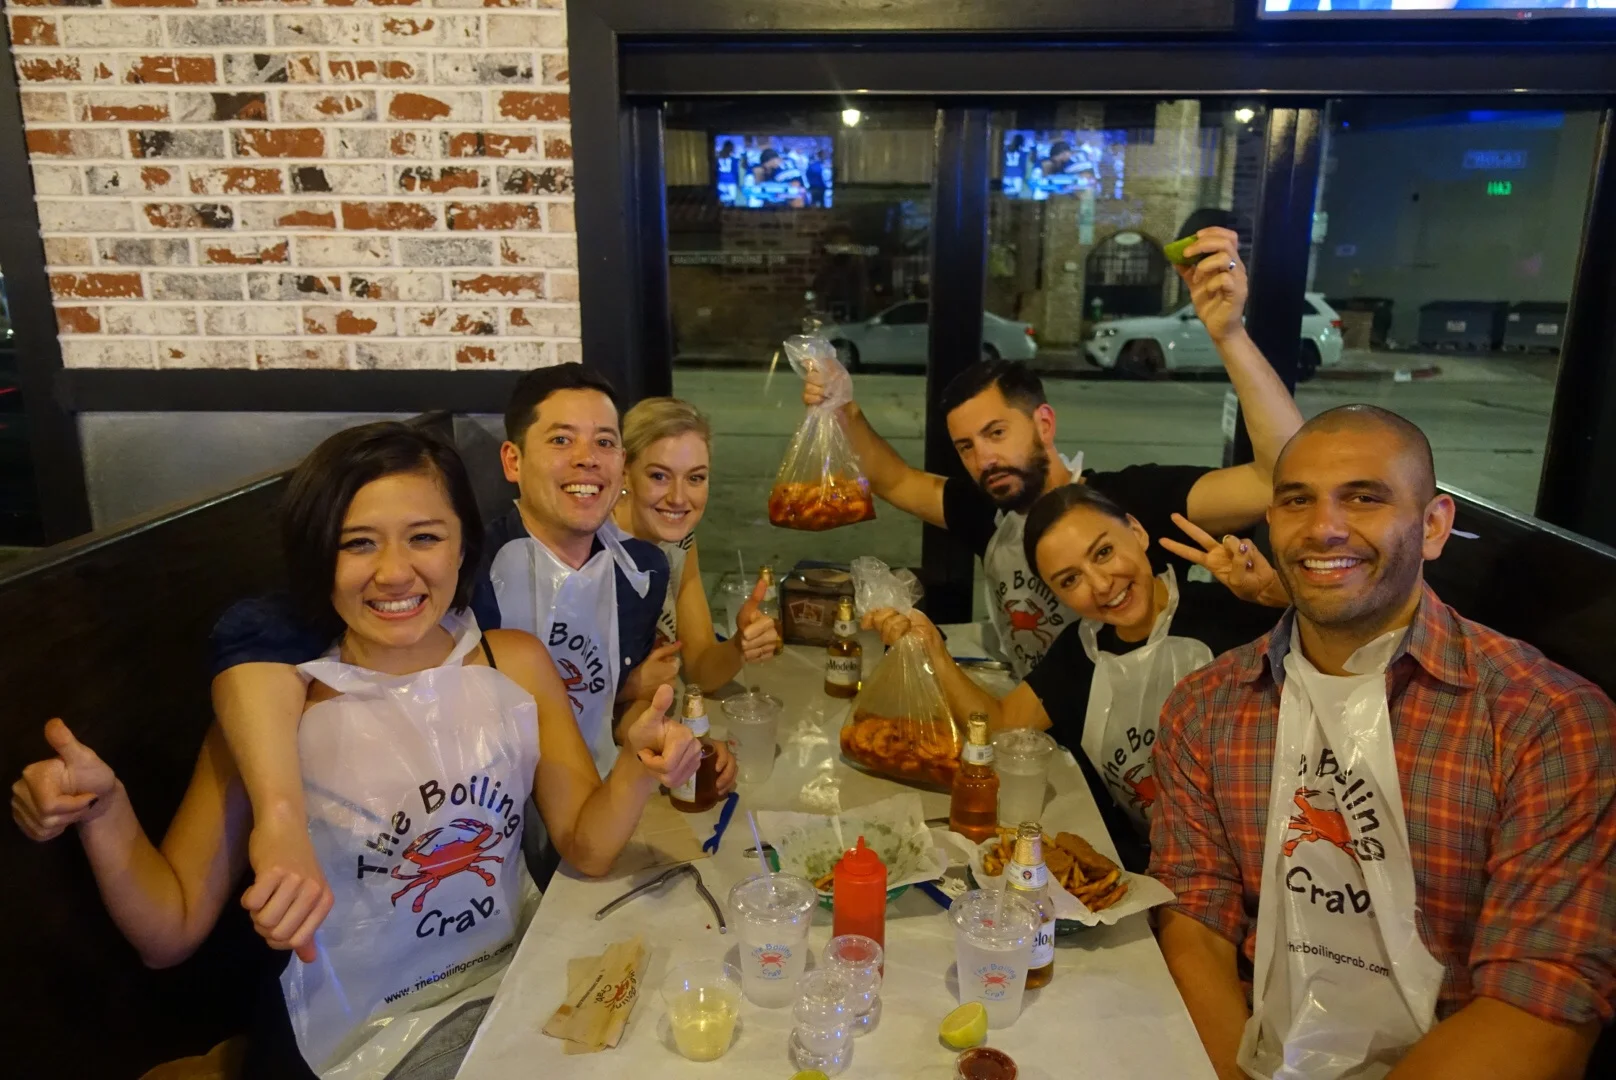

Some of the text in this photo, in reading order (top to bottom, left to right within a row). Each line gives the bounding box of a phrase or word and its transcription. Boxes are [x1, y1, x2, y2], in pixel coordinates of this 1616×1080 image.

[1014, 570, 1064, 626] Boiling
[1102, 748, 1127, 788] The
[356, 775, 521, 879] The Boiling
[1286, 866, 1371, 914] Crab
[416, 896, 495, 938] Crab
[765, 943, 792, 959] Boiling
[1287, 941, 1389, 978] heboilingcrab.com
[762, 968, 782, 977] Crab
[990, 963, 1017, 980] Boiling
[984, 988, 1005, 998] Crab
